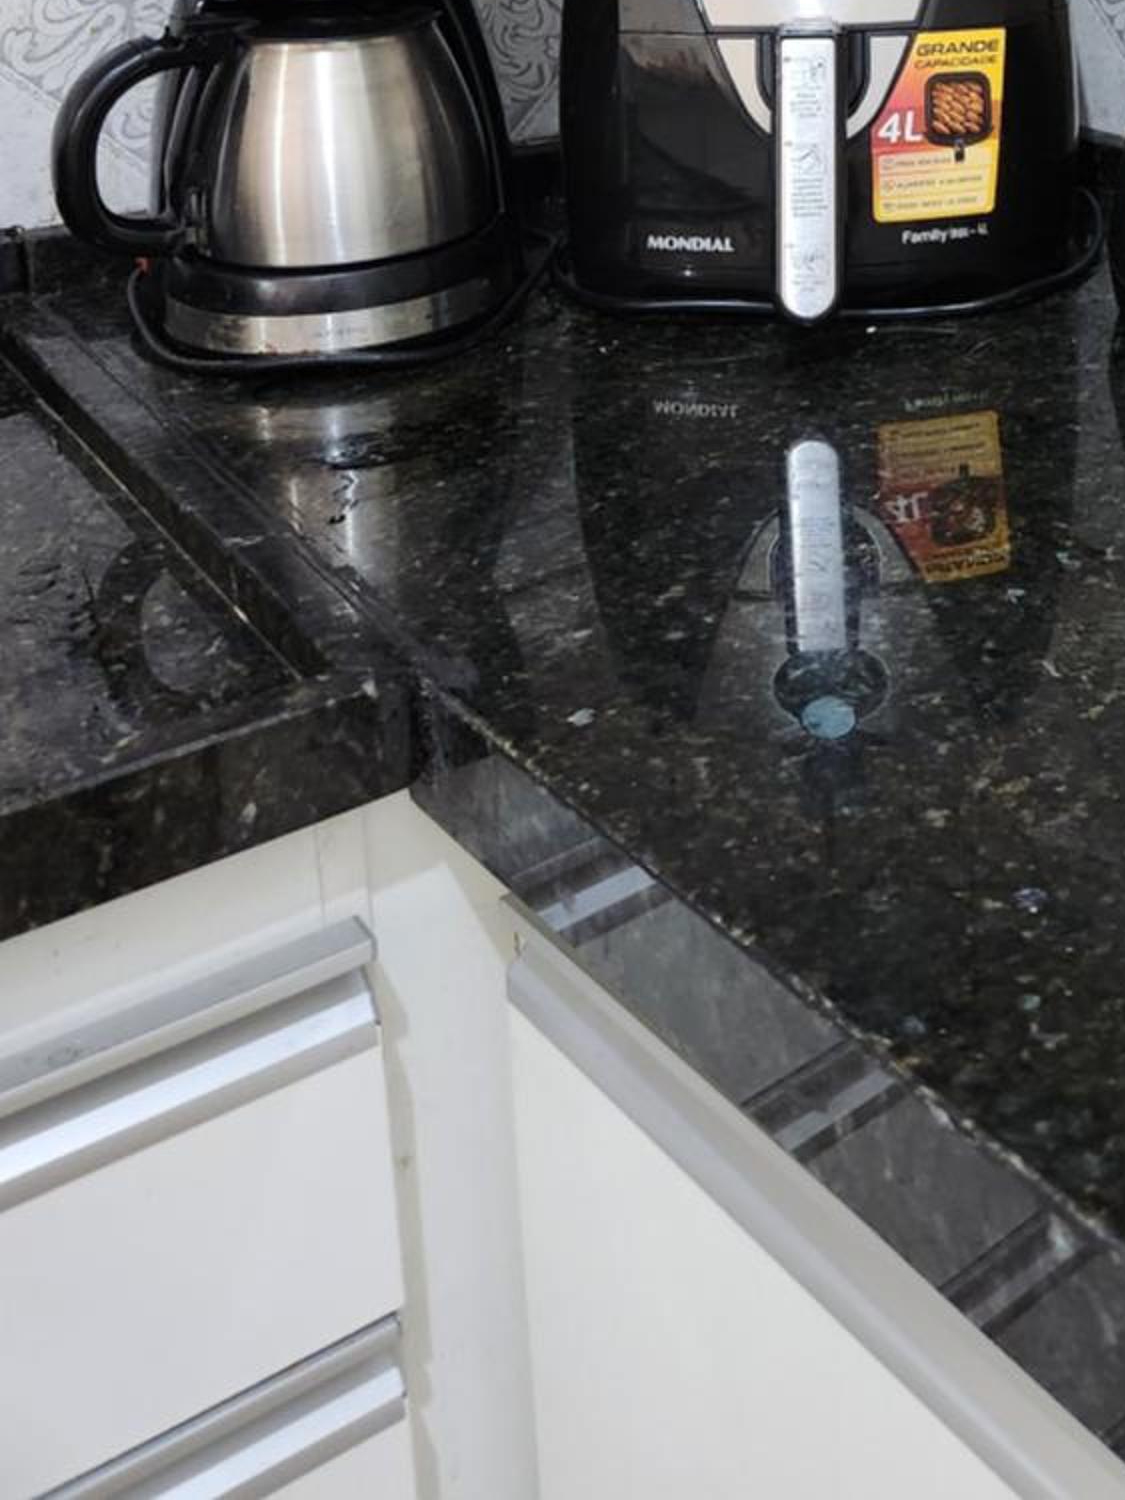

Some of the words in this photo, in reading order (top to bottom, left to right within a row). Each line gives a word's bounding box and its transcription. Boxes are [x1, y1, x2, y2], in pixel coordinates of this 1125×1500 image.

[915, 39, 1000, 57] GRANDE
[877, 109, 924, 144] 4L
[646, 233, 736, 253] MONDIAL
